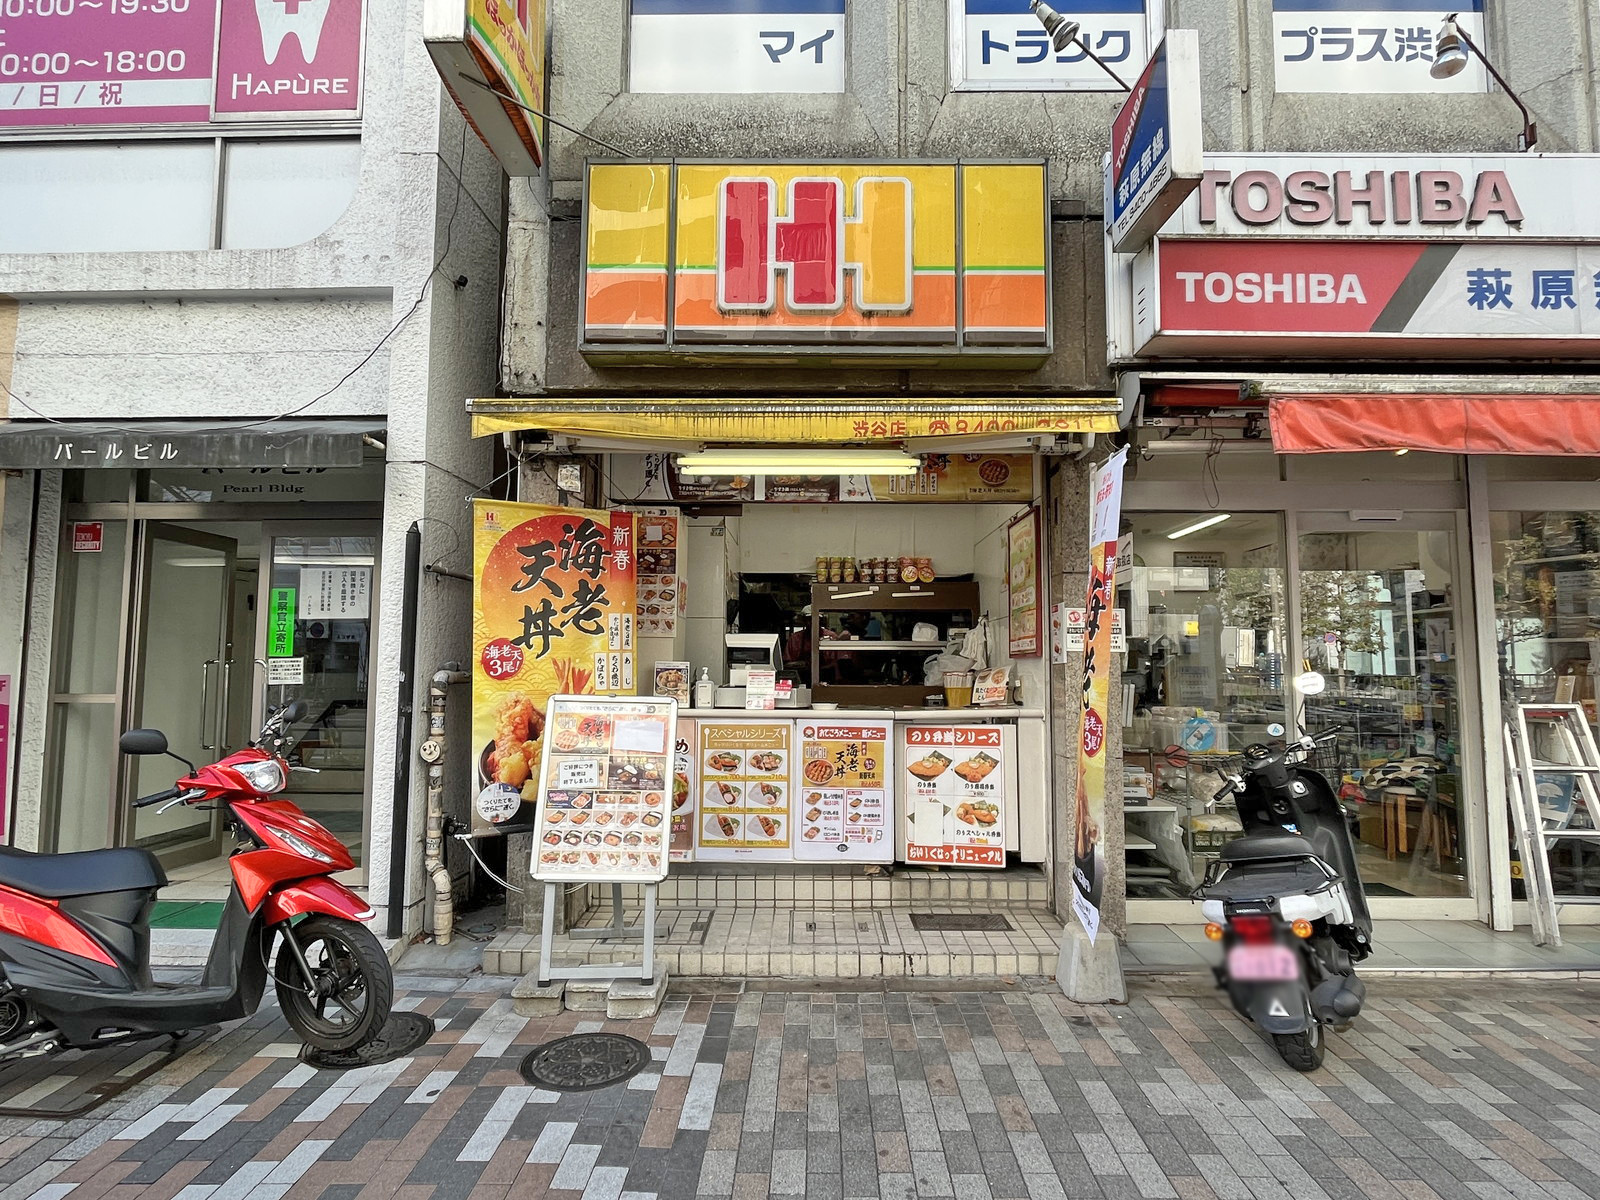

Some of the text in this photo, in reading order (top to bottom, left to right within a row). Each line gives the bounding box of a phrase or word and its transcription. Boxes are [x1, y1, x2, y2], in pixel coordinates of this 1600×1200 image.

[759, 29, 834, 64] マイ
[1116, 86, 1146, 169] TOSHIBA
[1118, 126, 1165, 208] 萩原無線
[1199, 170, 1524, 225] TOSHIBA
[1176, 271, 1367, 304] TOSHIBA
[1466, 267, 1600, 311] 萩原
[54, 442, 179, 461] パールビル
[223, 484, 304, 493] Pearl Bldg
[613, 525, 630, 570] 新春
[558, 519, 612, 635] 海老
[275, 591, 288, 653] 警察官立寄所
[510, 540, 565, 660] 天丼
[711, 728, 781, 738] スペシャルシリーズ
[846, 743, 859, 772] 海老
